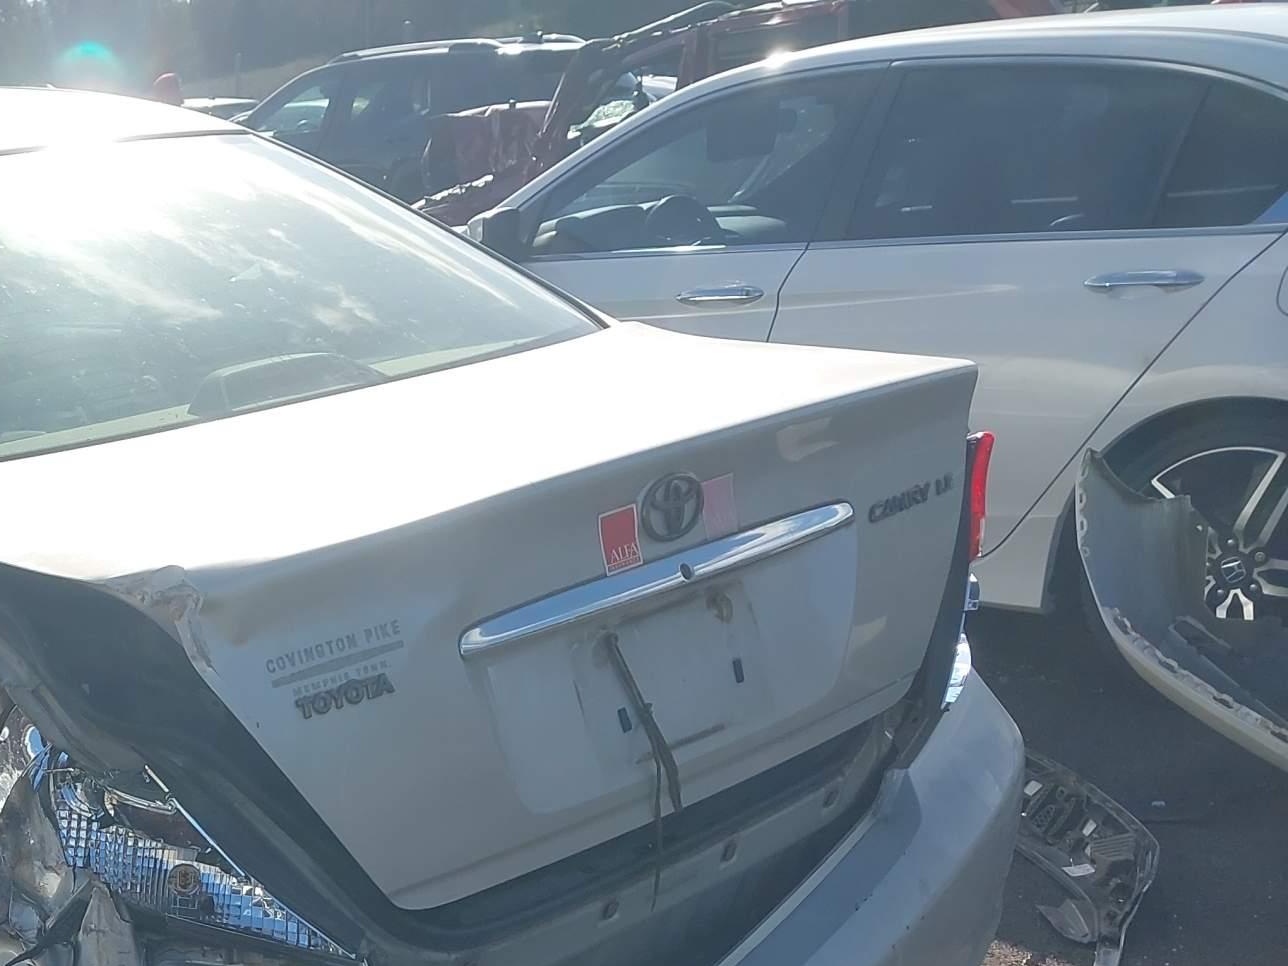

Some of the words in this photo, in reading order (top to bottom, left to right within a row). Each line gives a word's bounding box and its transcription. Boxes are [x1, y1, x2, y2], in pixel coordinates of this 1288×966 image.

[868, 481, 930, 523] CAMRY
[610, 543, 640, 564] ALFA
[266, 633, 358, 674] COVINGTON
[363, 619, 401, 644] PIKE
[295, 672, 396, 719] TOYOTA
